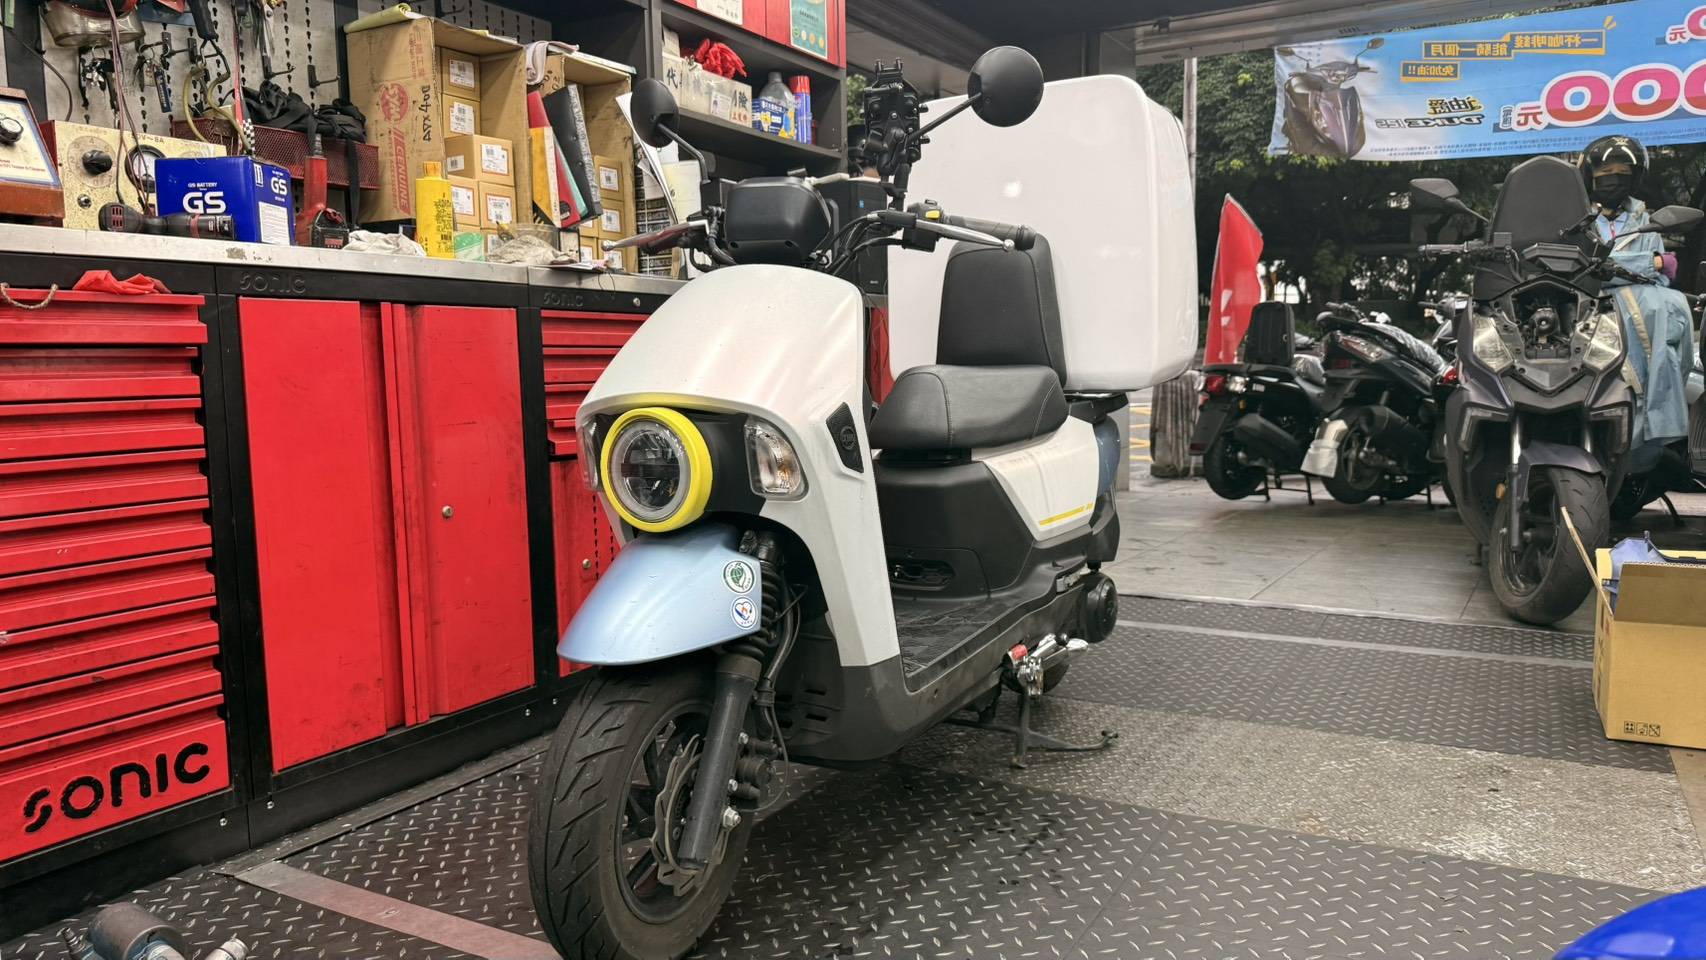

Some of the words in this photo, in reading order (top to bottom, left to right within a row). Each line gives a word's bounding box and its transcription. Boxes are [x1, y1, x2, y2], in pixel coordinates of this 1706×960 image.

[384, 87, 402, 121] SYM
[271, 176, 288, 196] GS
[395, 145, 409, 209] GENUINE
[183, 191, 226, 214] GS
